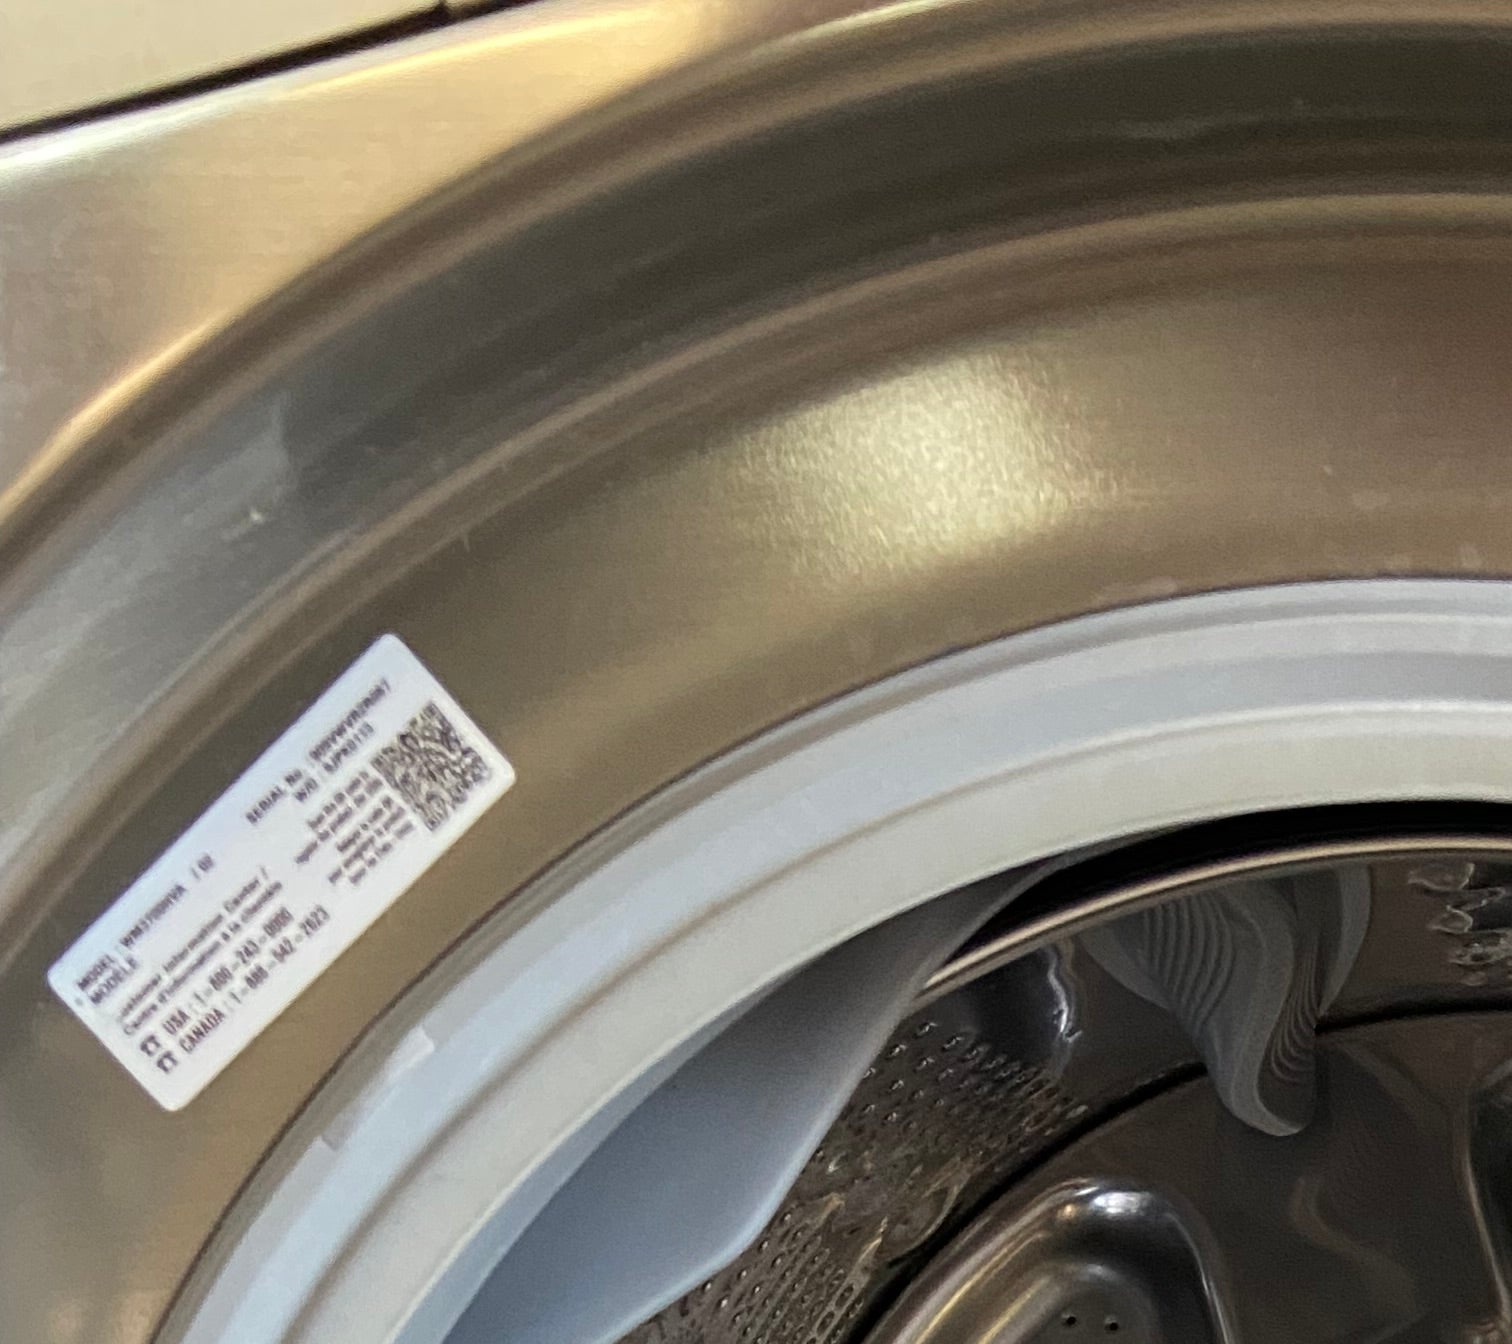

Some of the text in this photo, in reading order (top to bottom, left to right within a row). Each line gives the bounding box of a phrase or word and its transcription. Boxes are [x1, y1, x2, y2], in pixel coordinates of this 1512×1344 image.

[244, 783, 286, 826] SERIAL
[75, 952, 115, 993] MODEL
[161, 1006, 191, 1037] USA
[178, 1005, 226, 1054] CANADA
